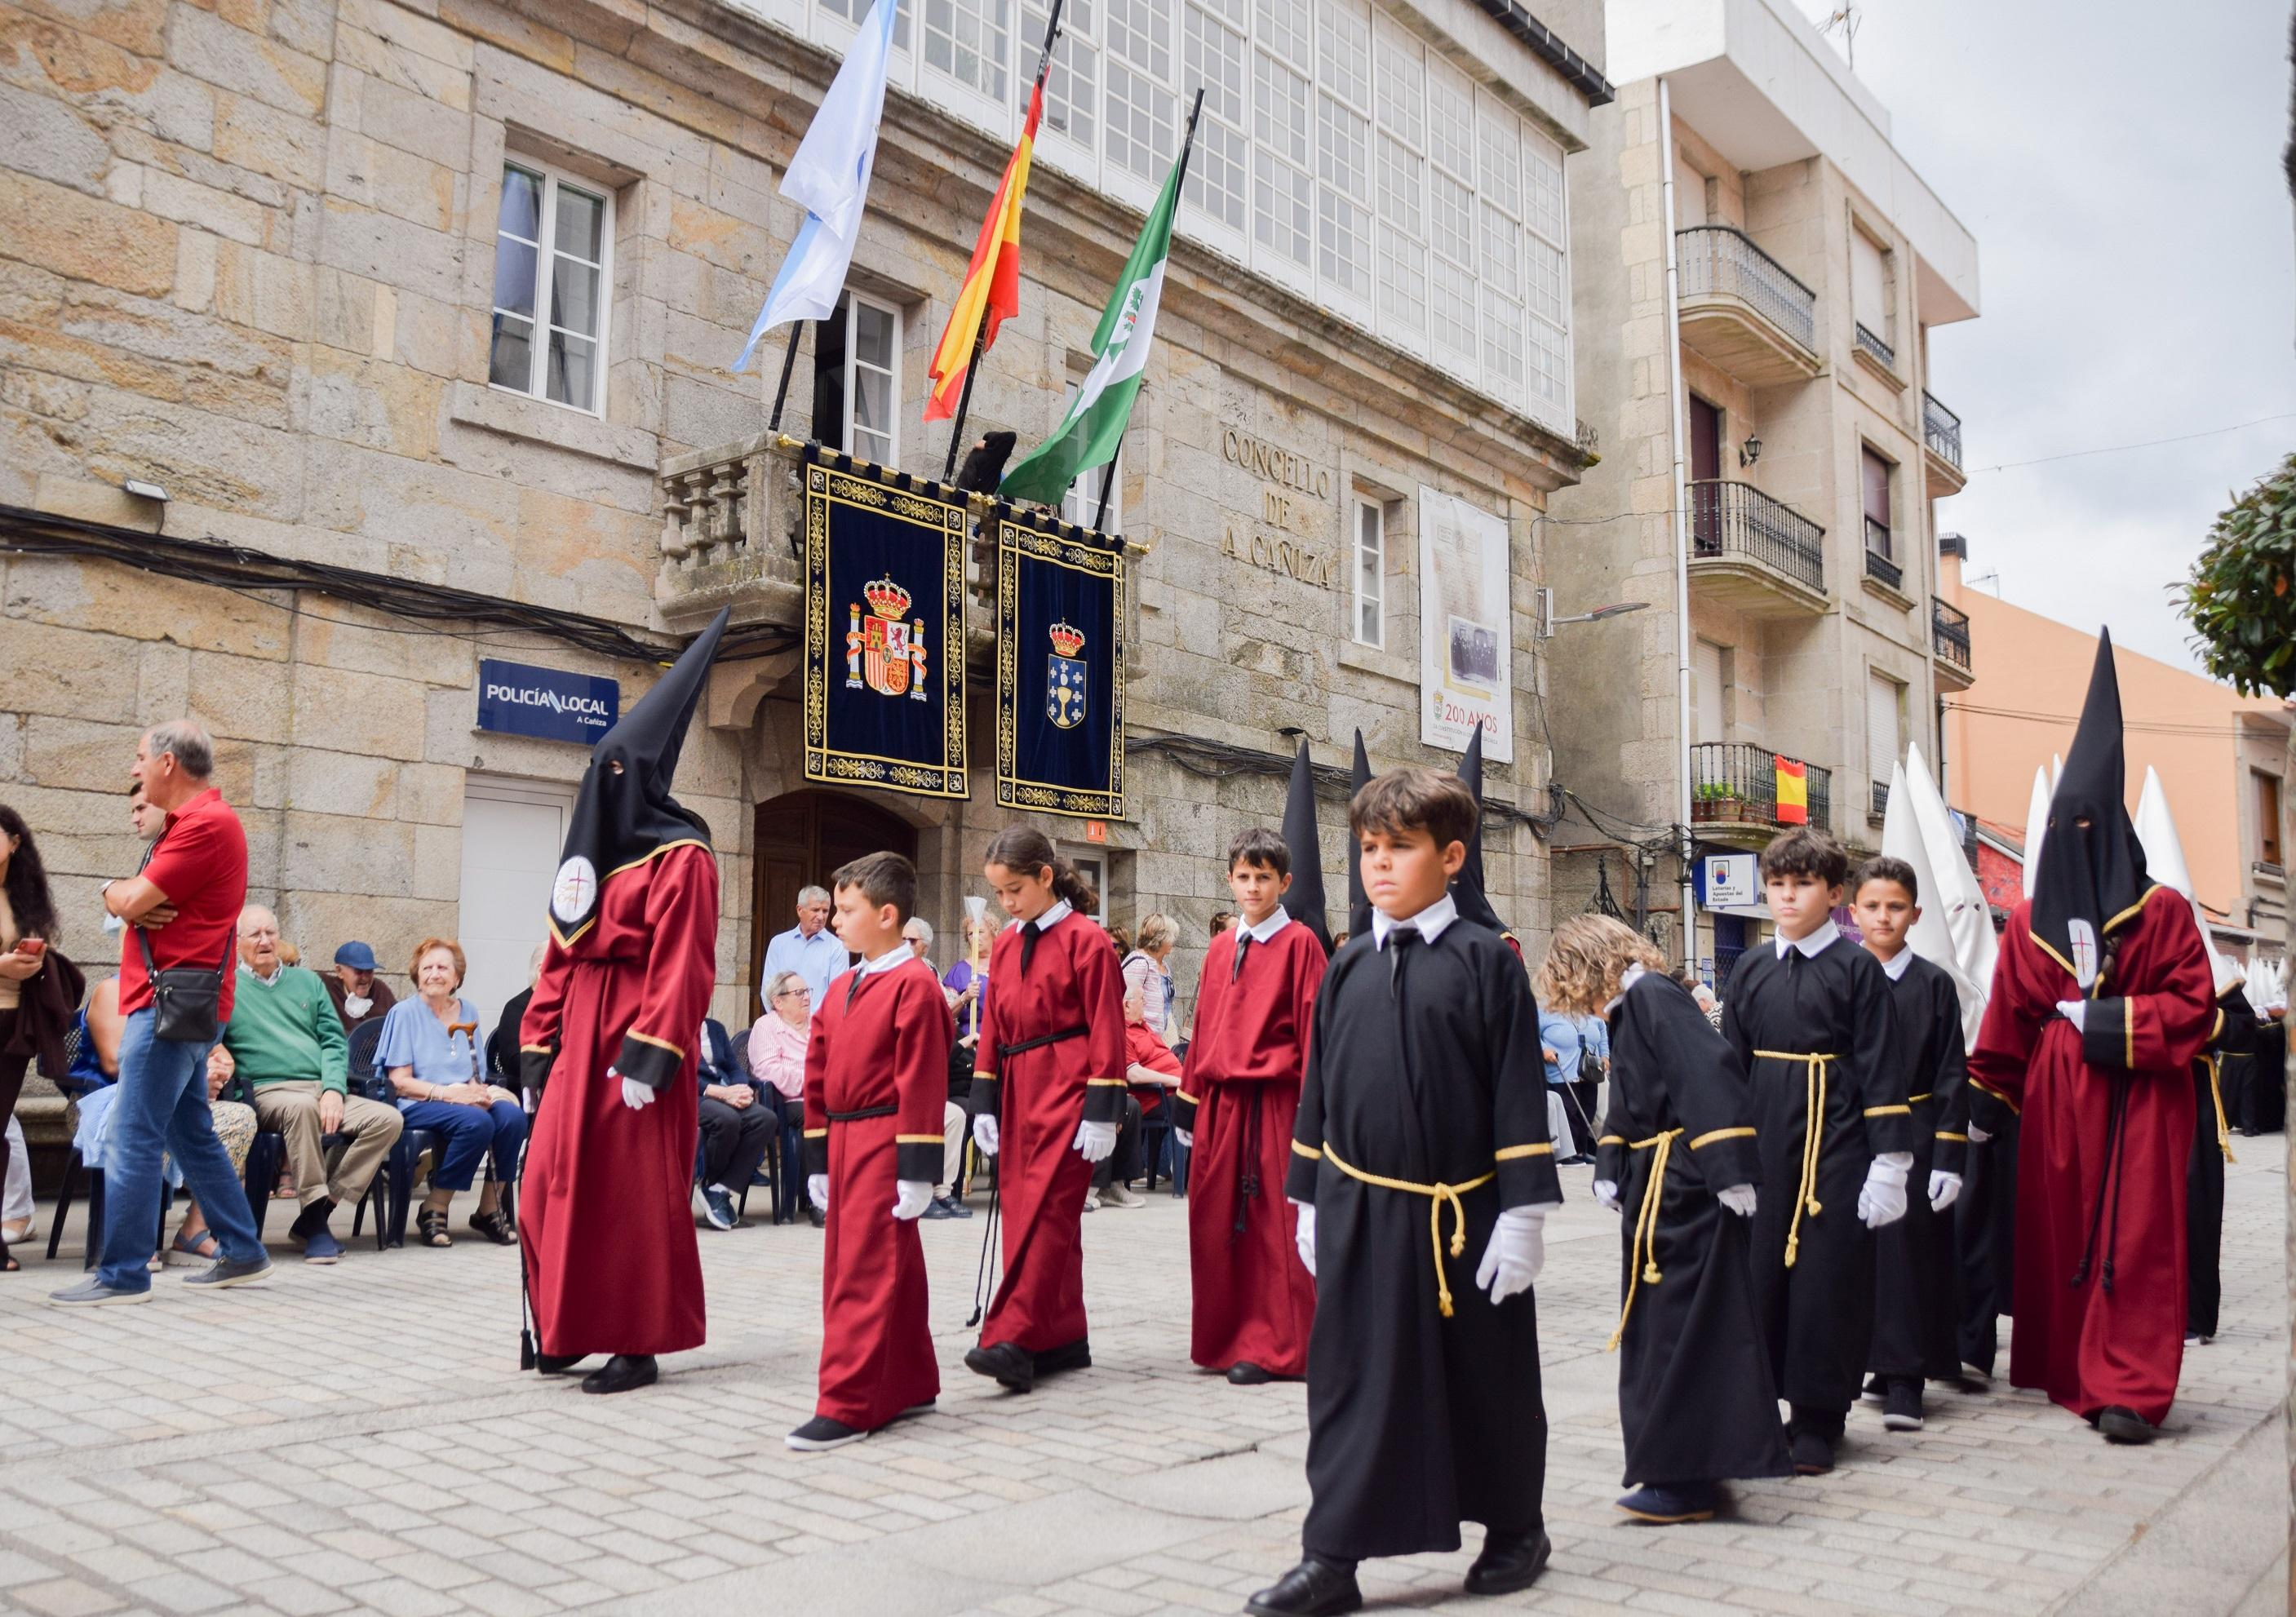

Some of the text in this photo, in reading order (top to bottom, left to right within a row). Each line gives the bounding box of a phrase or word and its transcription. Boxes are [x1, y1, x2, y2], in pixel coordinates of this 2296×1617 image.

[1224, 430, 1328, 498] CONCELLO
[1265, 492, 1291, 529] DE
[1222, 526, 1235, 556] A
[487, 684, 609, 715] POLICÍA LOCAL
[1445, 703, 1465, 725] 200
[576, 715, 607, 727] A Cañiza
